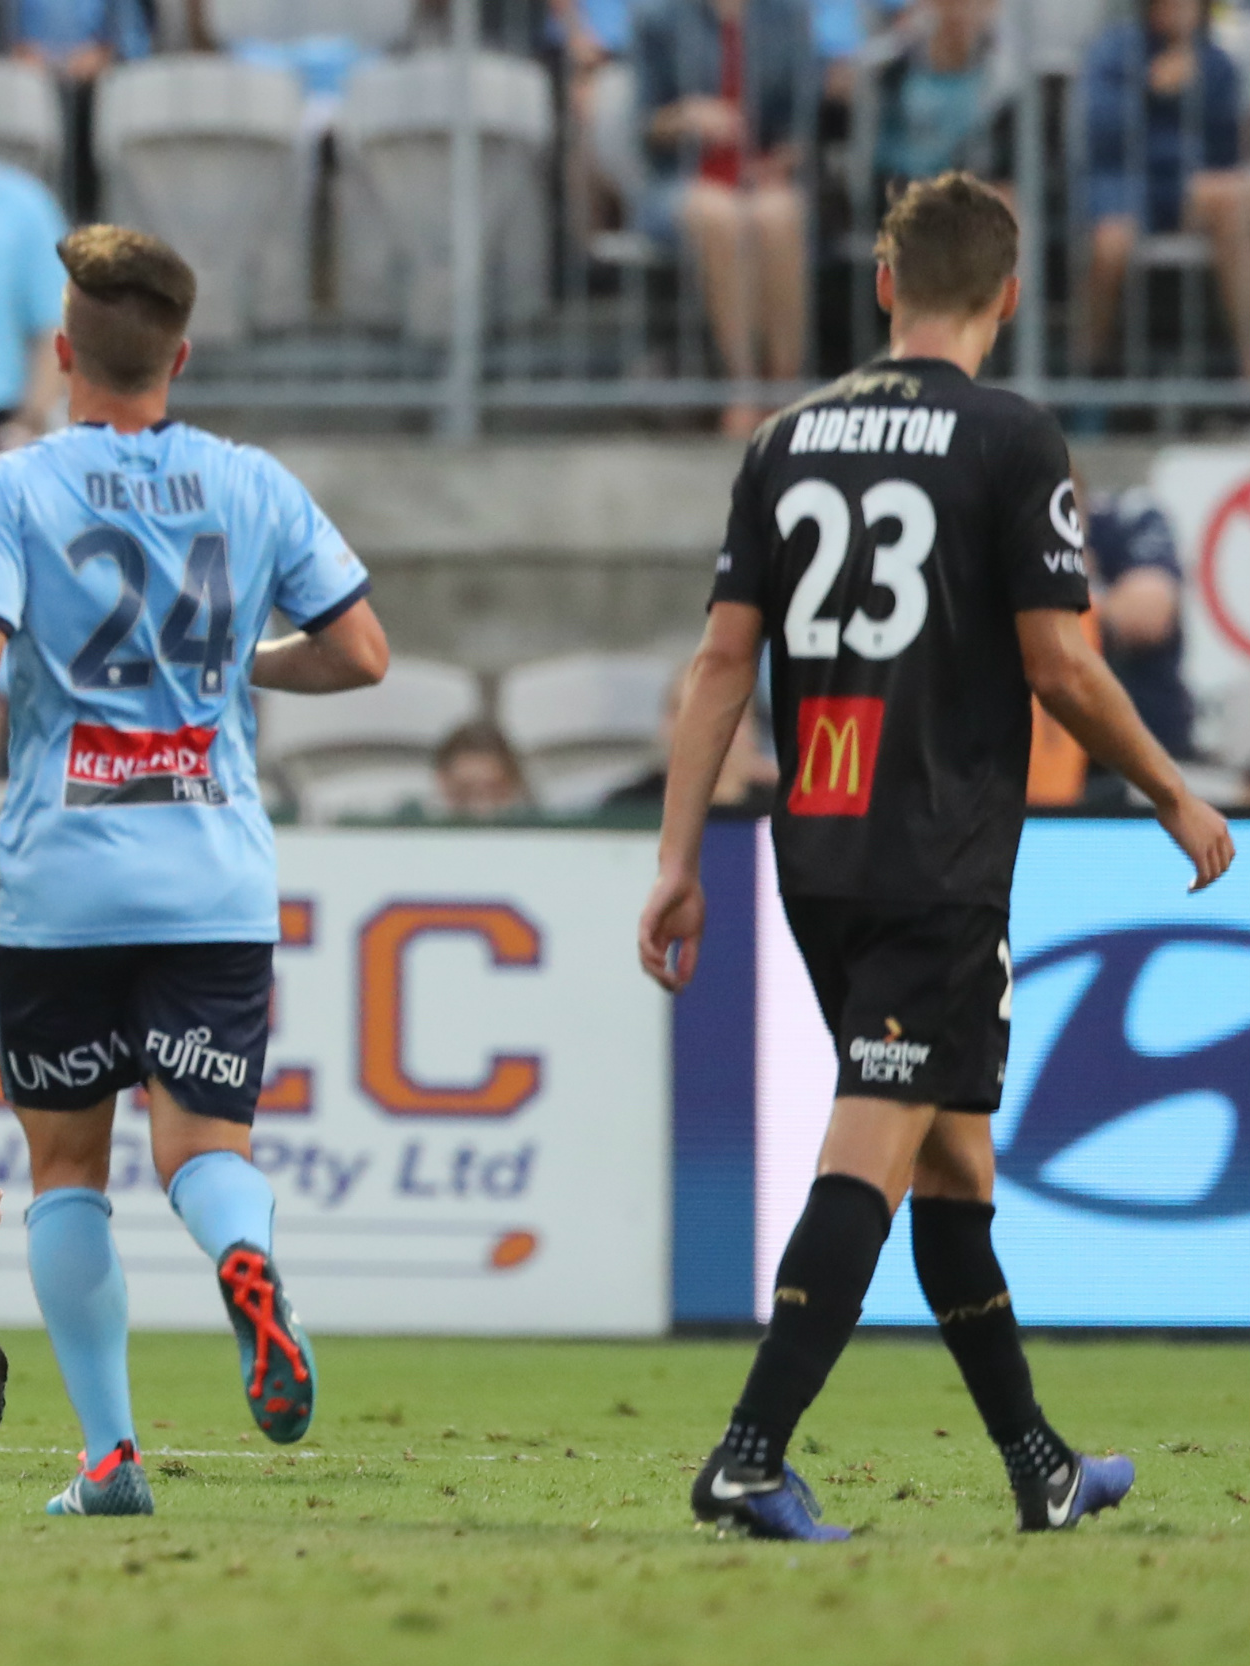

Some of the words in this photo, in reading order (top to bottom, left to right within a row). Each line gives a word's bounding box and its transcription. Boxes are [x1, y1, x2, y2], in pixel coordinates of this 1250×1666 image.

[789, 407, 957, 457] RIDENTON
[85, 471, 205, 515] DEVLIN
[775, 477, 937, 661] 23
[64, 528, 235, 696] 24
[145, 1026, 248, 1088] FUJITSU
[849, 1036, 930, 1065] Greater
[397, 1136, 536, 1202] Ltd
